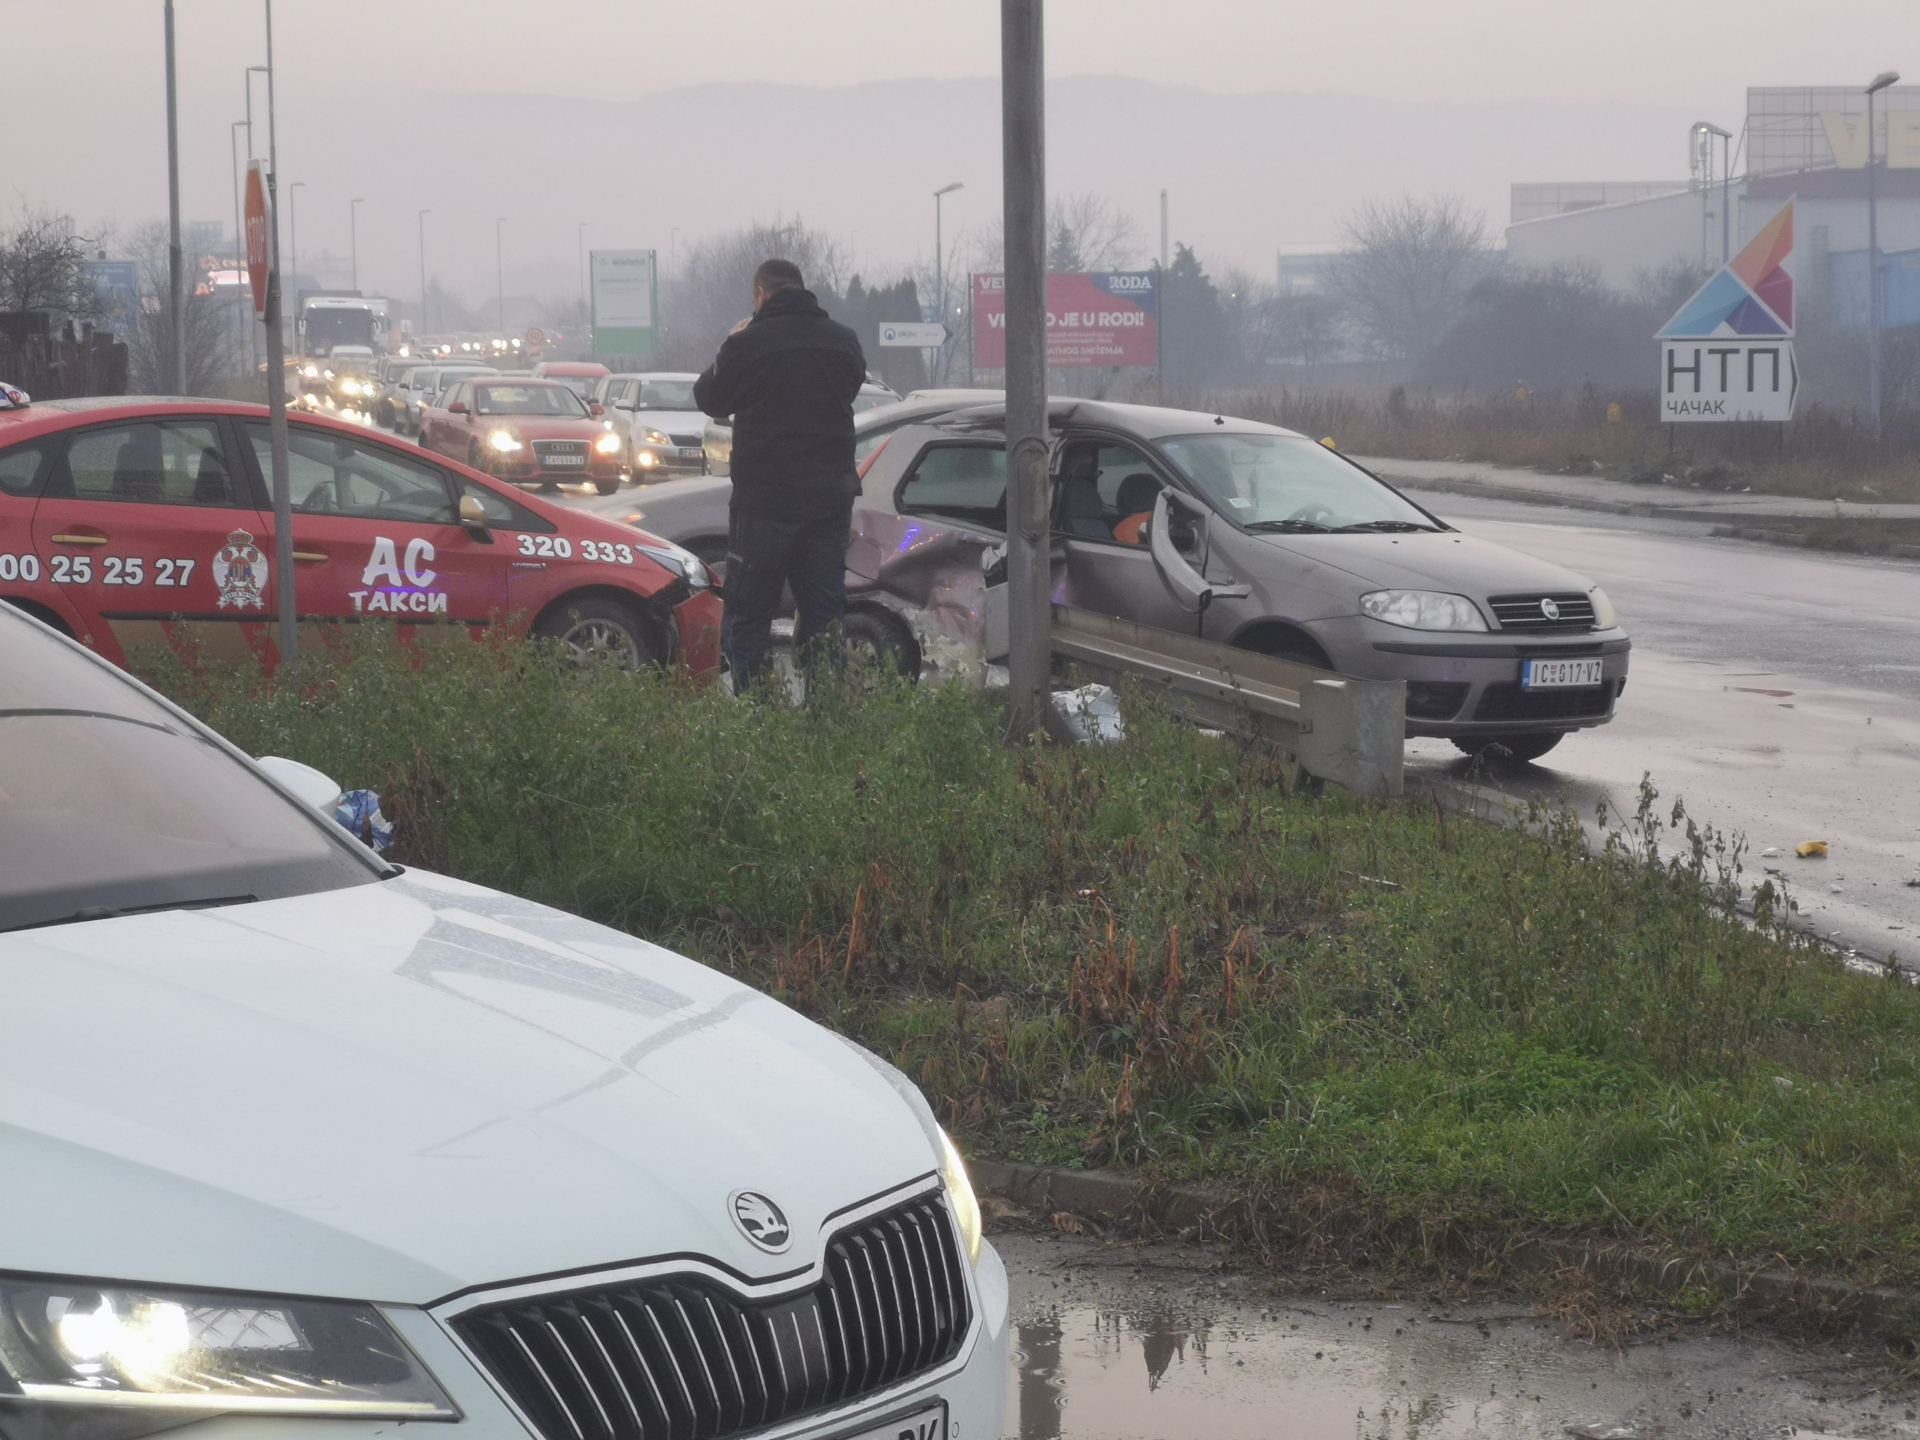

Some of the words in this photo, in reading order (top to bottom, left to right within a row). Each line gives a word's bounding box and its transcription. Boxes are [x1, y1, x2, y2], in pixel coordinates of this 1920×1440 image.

[1108, 276, 1153, 290] RODA
[1058, 312, 1079, 327] JE
[1082, 311, 1095, 327] U
[1098, 311, 1145, 327] RODI!
[1667, 348, 1780, 393] НТП
[1667, 400, 1726, 415] ЧАЧАК
[516, 534, 573, 559] 320
[580, 540, 635, 565] 333
[50, 556, 92, 584] 25
[103, 557, 144, 585] 25
[155, 559, 195, 586] 27
[348, 591, 448, 614] ТАКСИ
